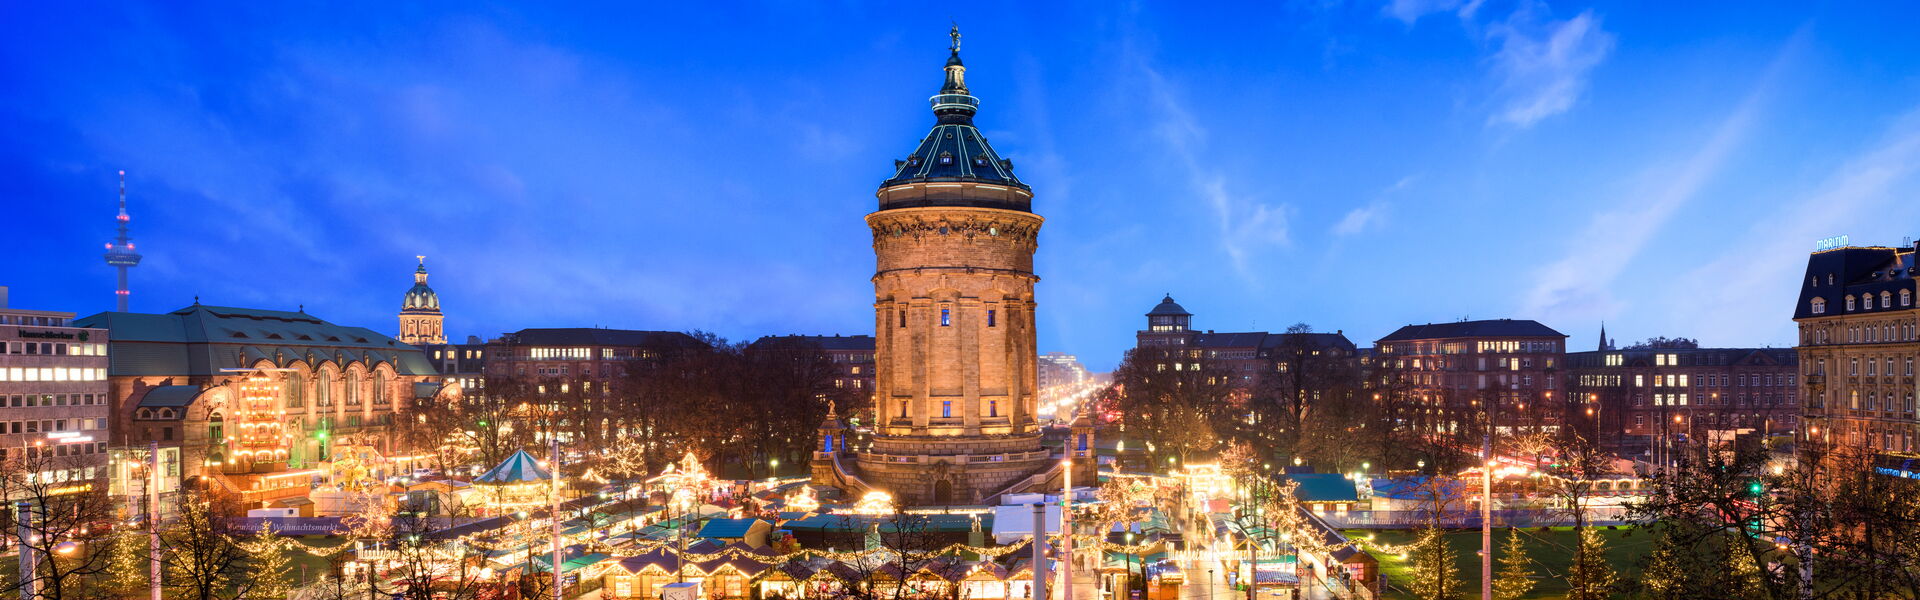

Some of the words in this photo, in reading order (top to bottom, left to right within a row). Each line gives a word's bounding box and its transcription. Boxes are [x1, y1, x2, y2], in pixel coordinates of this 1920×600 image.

[1816, 235, 1849, 251] MARITIM
[1399, 516, 1466, 525] Weihnhsmarkt
[273, 523, 338, 531] Weihnachtsmarkt
